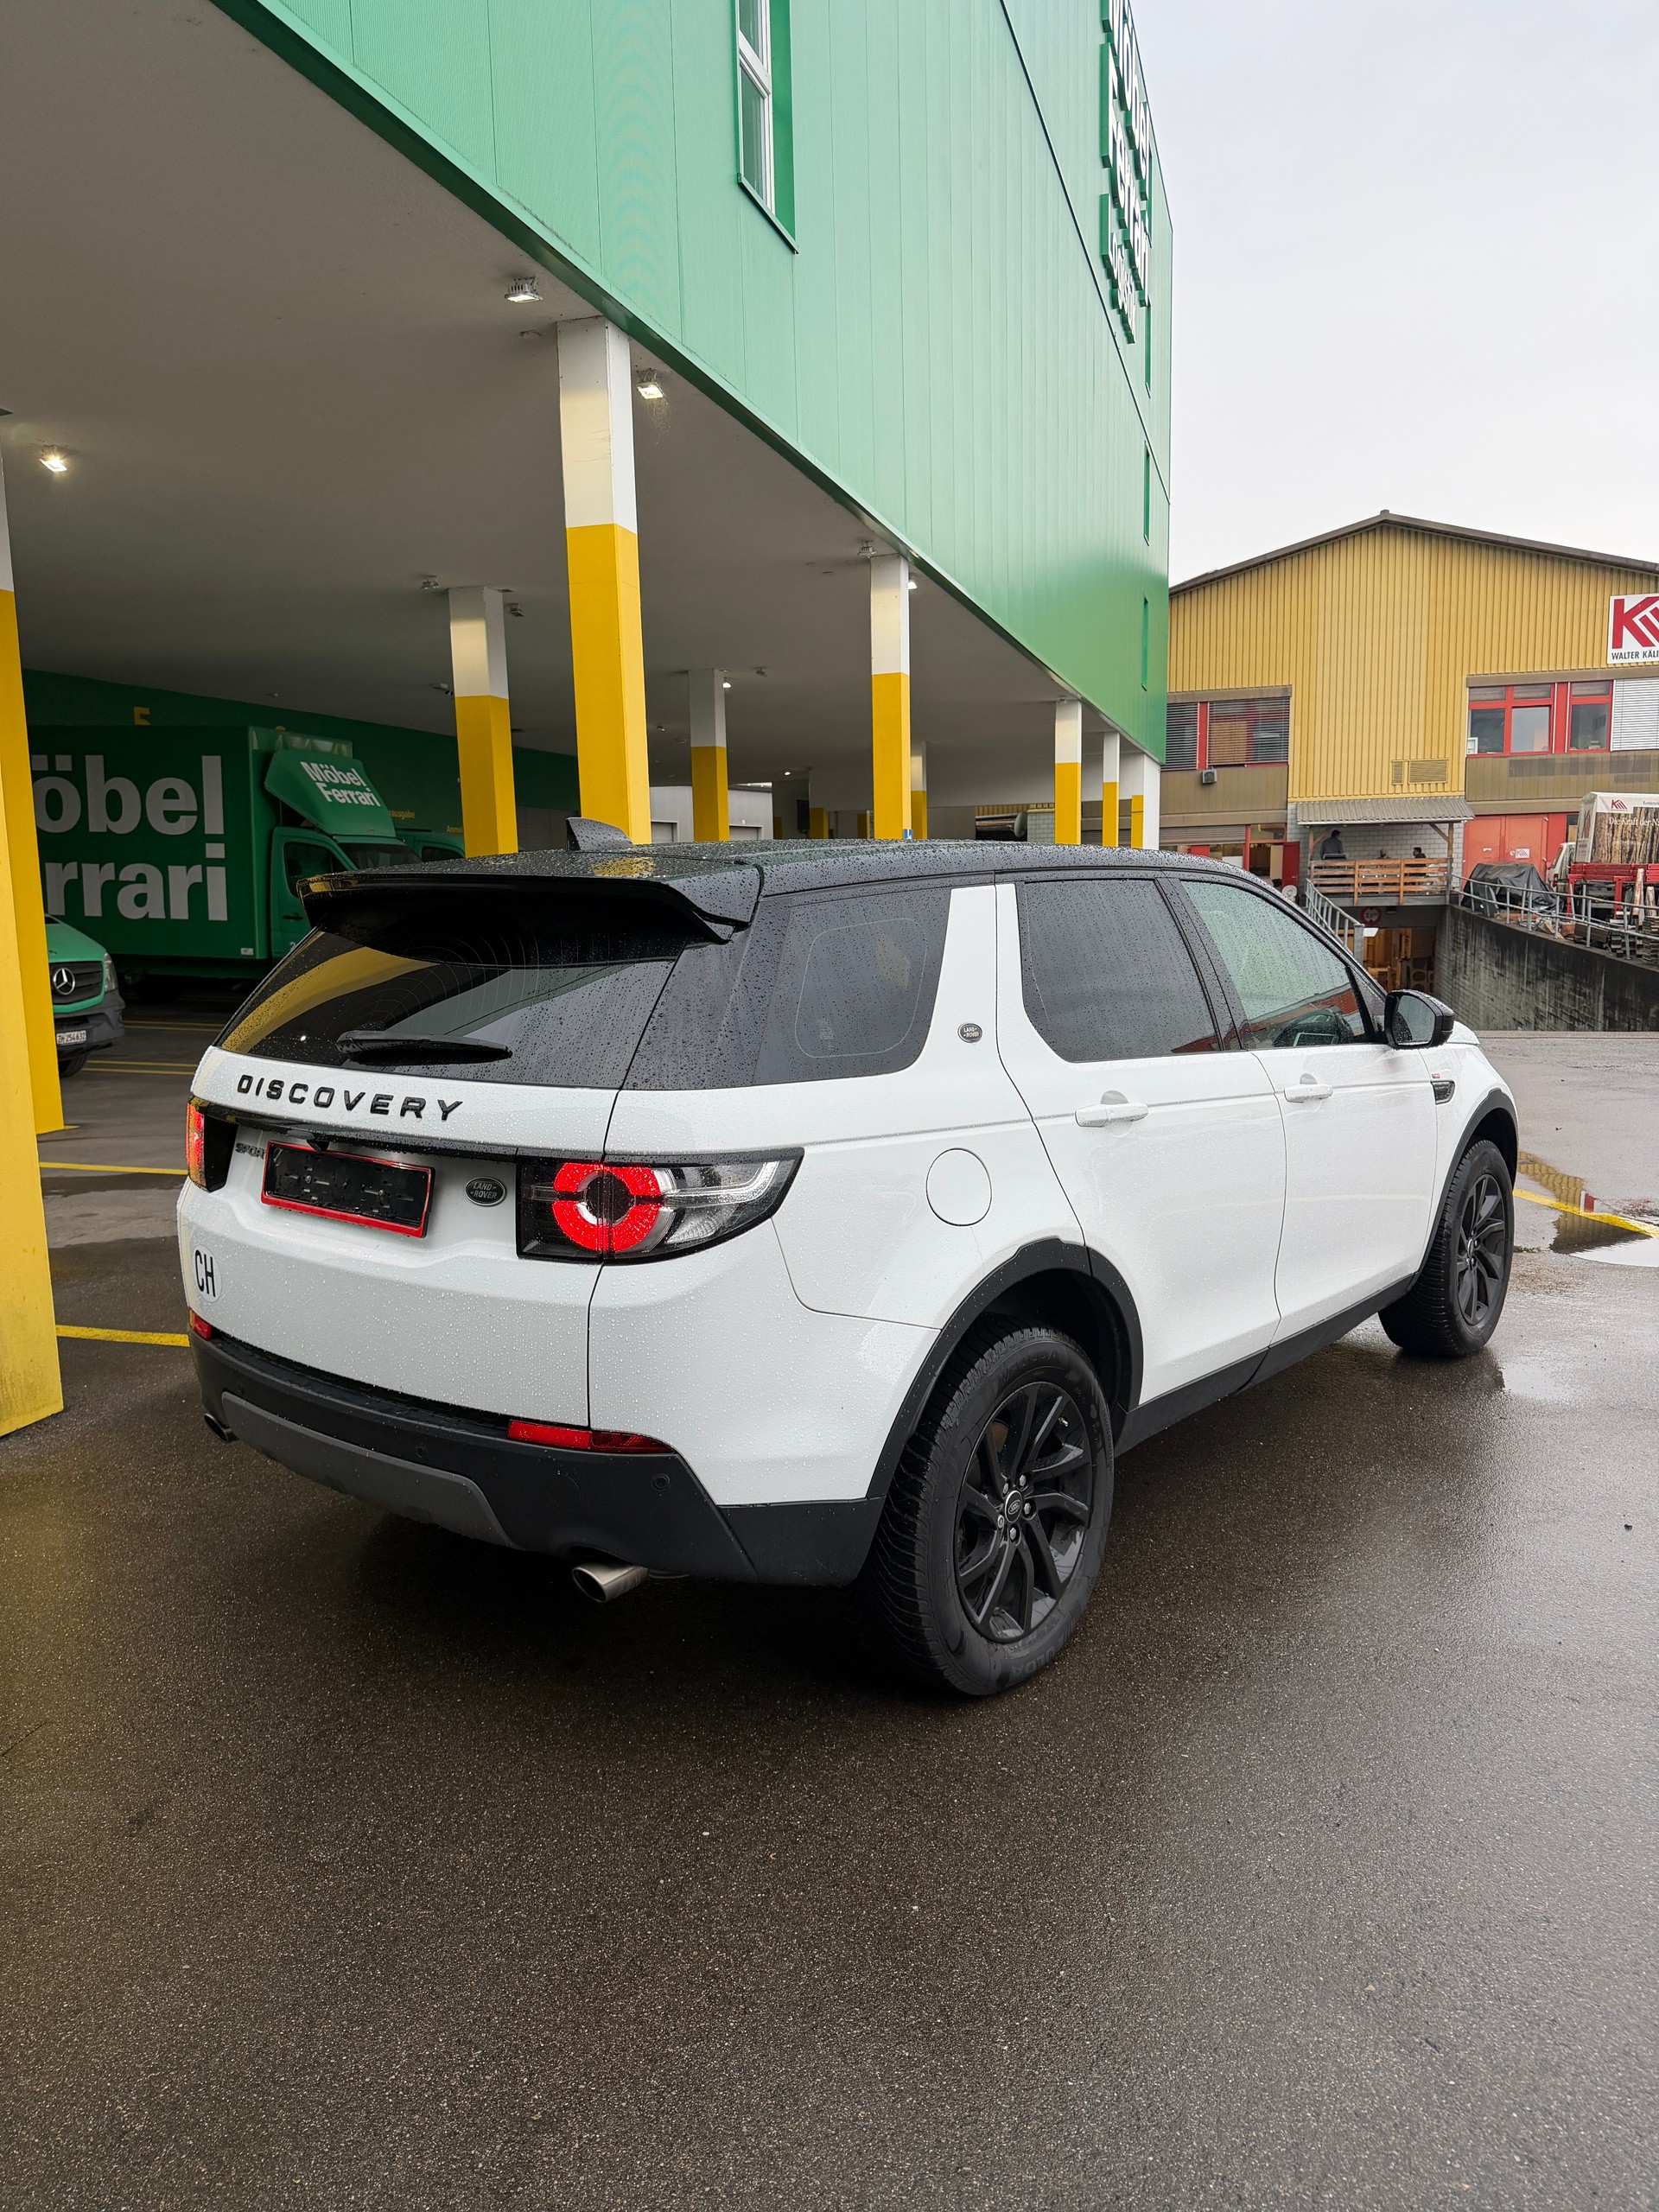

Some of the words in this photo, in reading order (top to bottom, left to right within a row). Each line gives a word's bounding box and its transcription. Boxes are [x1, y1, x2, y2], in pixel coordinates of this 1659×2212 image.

[1611, 651, 1639, 660] WALTER
[300, 761, 367, 786] Möbel
[315, 782, 381, 806] Ferrari
[1609, 817, 1620, 825] Die
[1622, 817, 1638, 826] Kraft
[237, 1074, 463, 1121] DISCOVERY
[194, 1249, 217, 1299] CH
